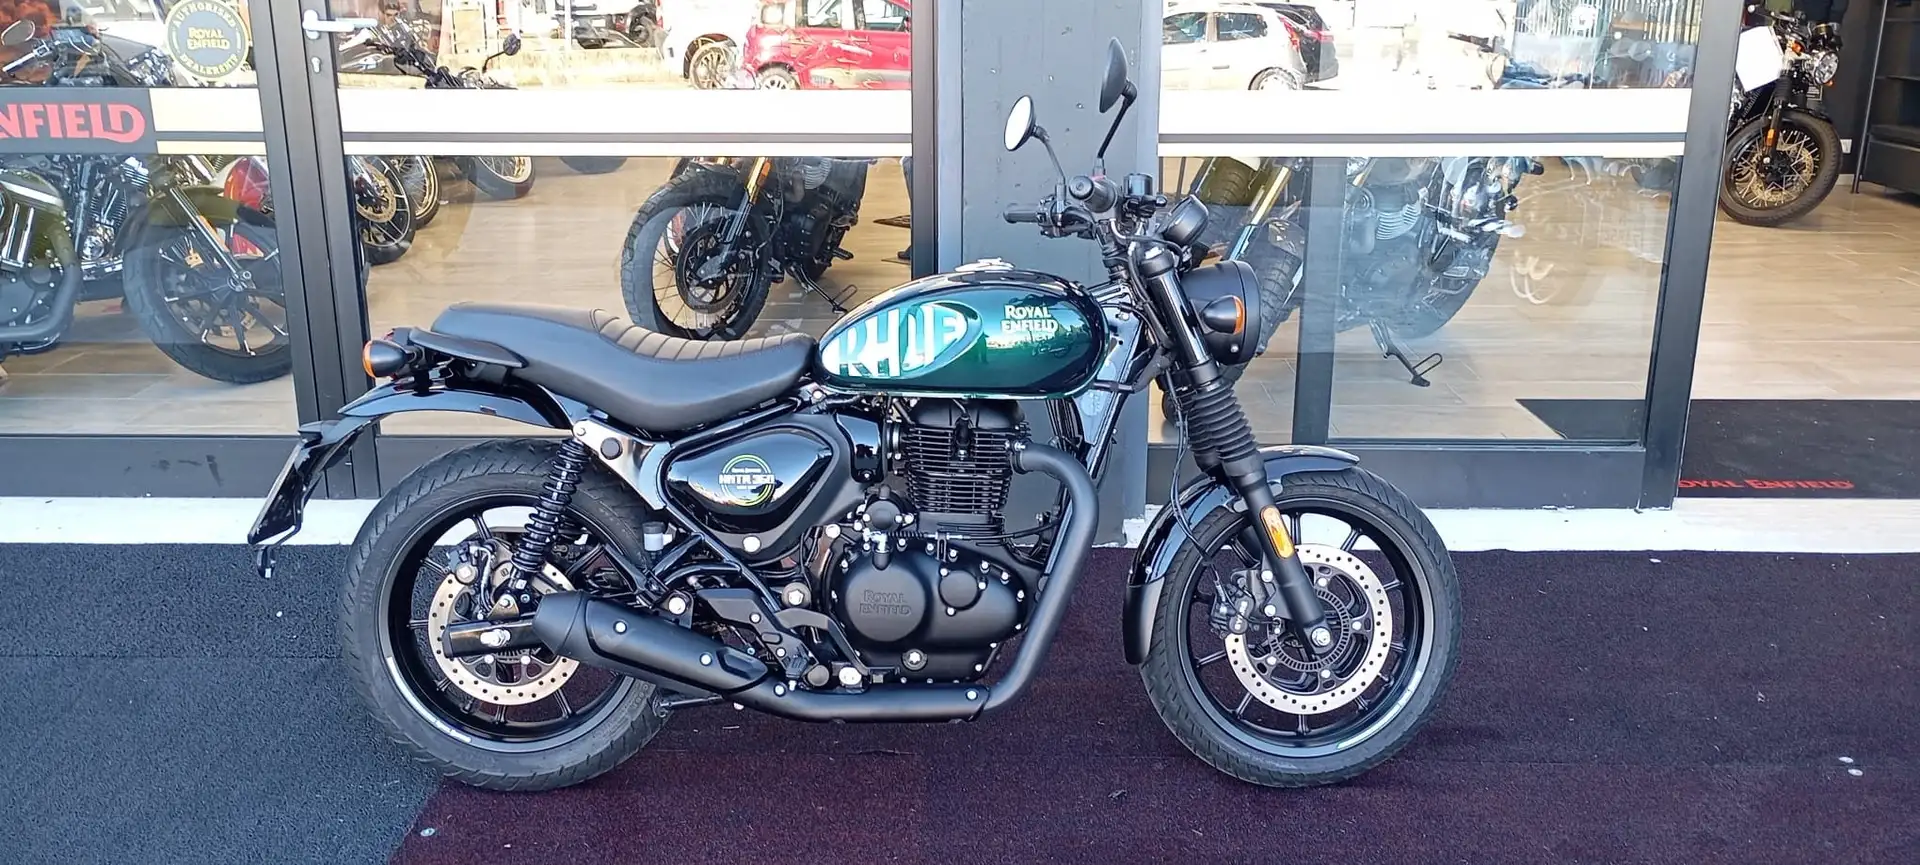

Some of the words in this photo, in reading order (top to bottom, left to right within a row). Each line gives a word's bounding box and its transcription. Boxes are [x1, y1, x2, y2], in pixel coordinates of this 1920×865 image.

[172, 2, 236, 28] AUTHORISED
[188, 27, 223, 39] ROYAL
[187, 38, 231, 50] ENFIELD
[180, 53, 239, 74] DEALERSHIP
[0, 103, 146, 143] NFIELD
[1004, 304, 1051, 320] ROYAL
[1001, 319, 1059, 334] ENFIELD
[1679, 480, 1744, 488] OYAL
[1744, 478, 1855, 489] ENFIELD
[863, 589, 907, 603] ROYAL
[859, 602, 912, 616] ENFIELD
